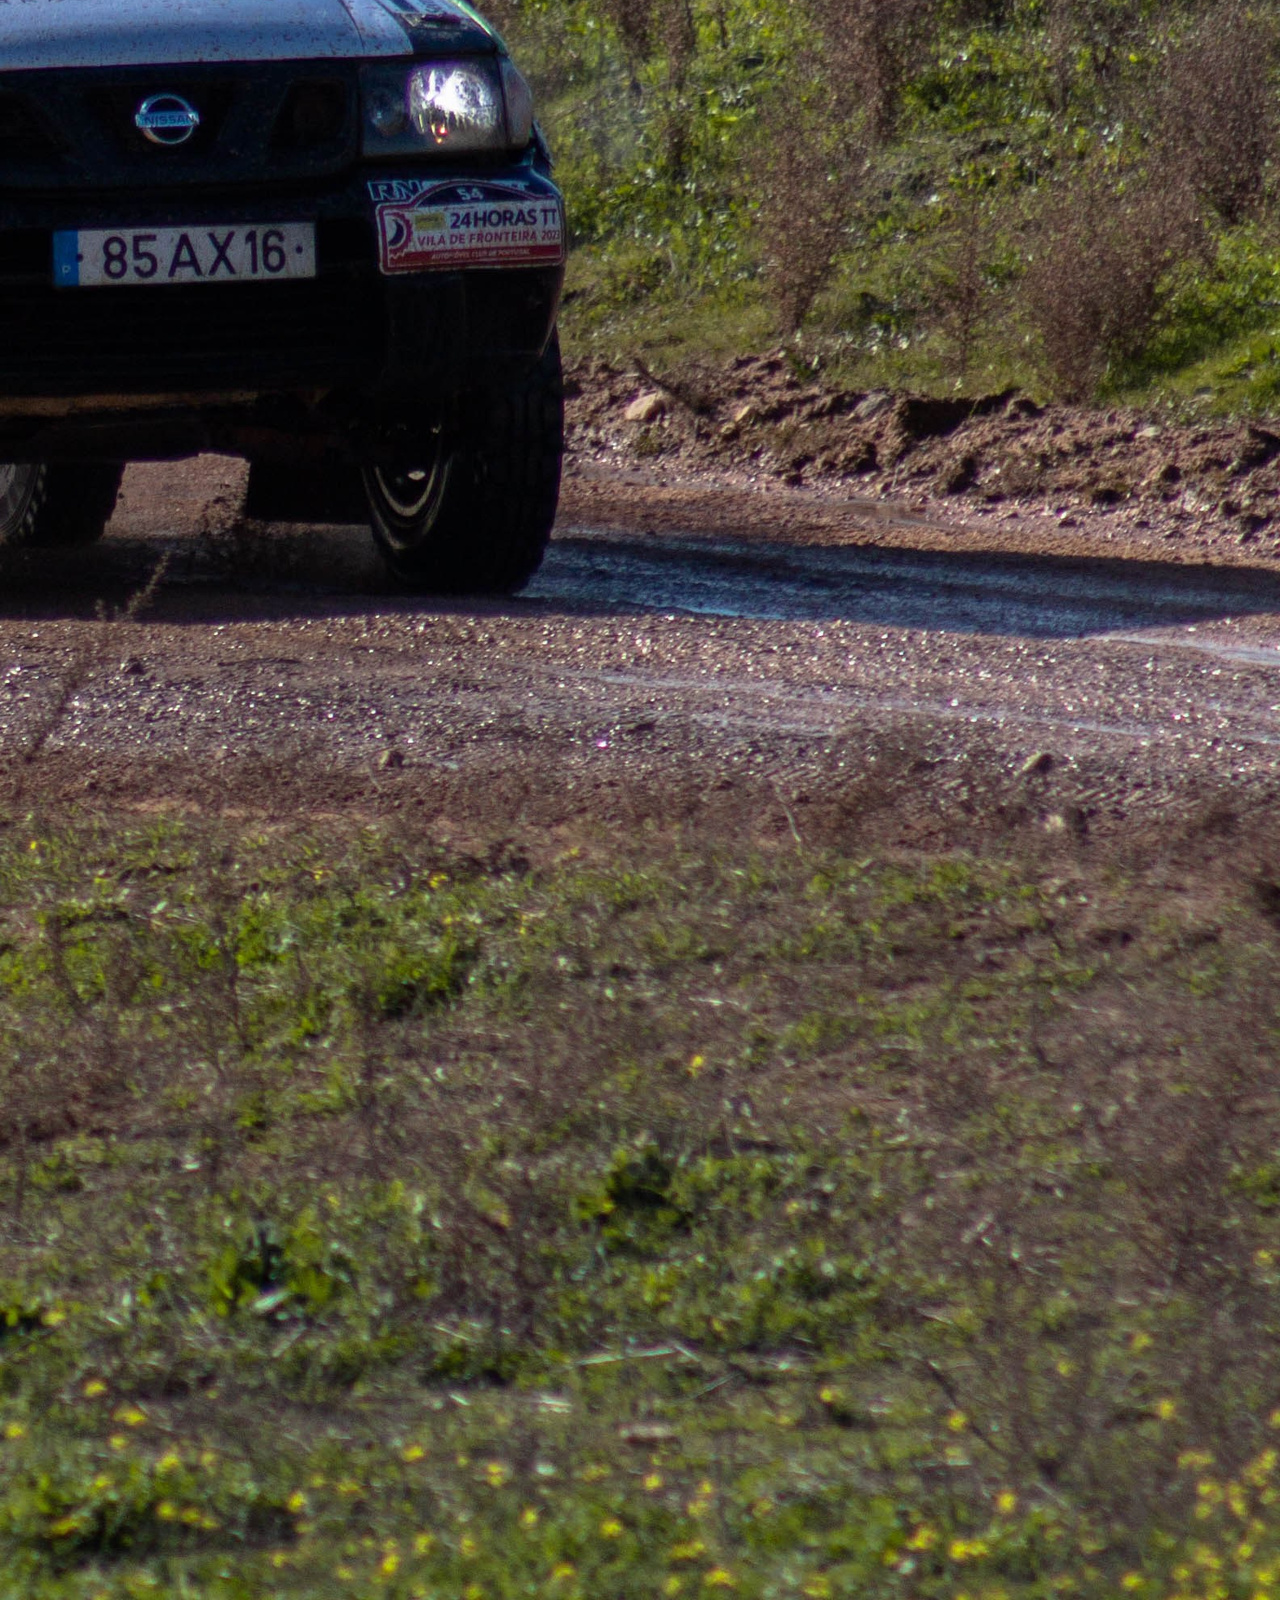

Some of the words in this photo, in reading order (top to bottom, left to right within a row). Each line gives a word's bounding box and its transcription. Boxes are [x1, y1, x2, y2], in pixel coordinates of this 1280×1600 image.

[142, 114, 196, 126] NISSAN
[417, 233, 447, 247] VILA
[449, 232, 466, 246] DE
[468, 230, 538, 245] FRONTEIRA
